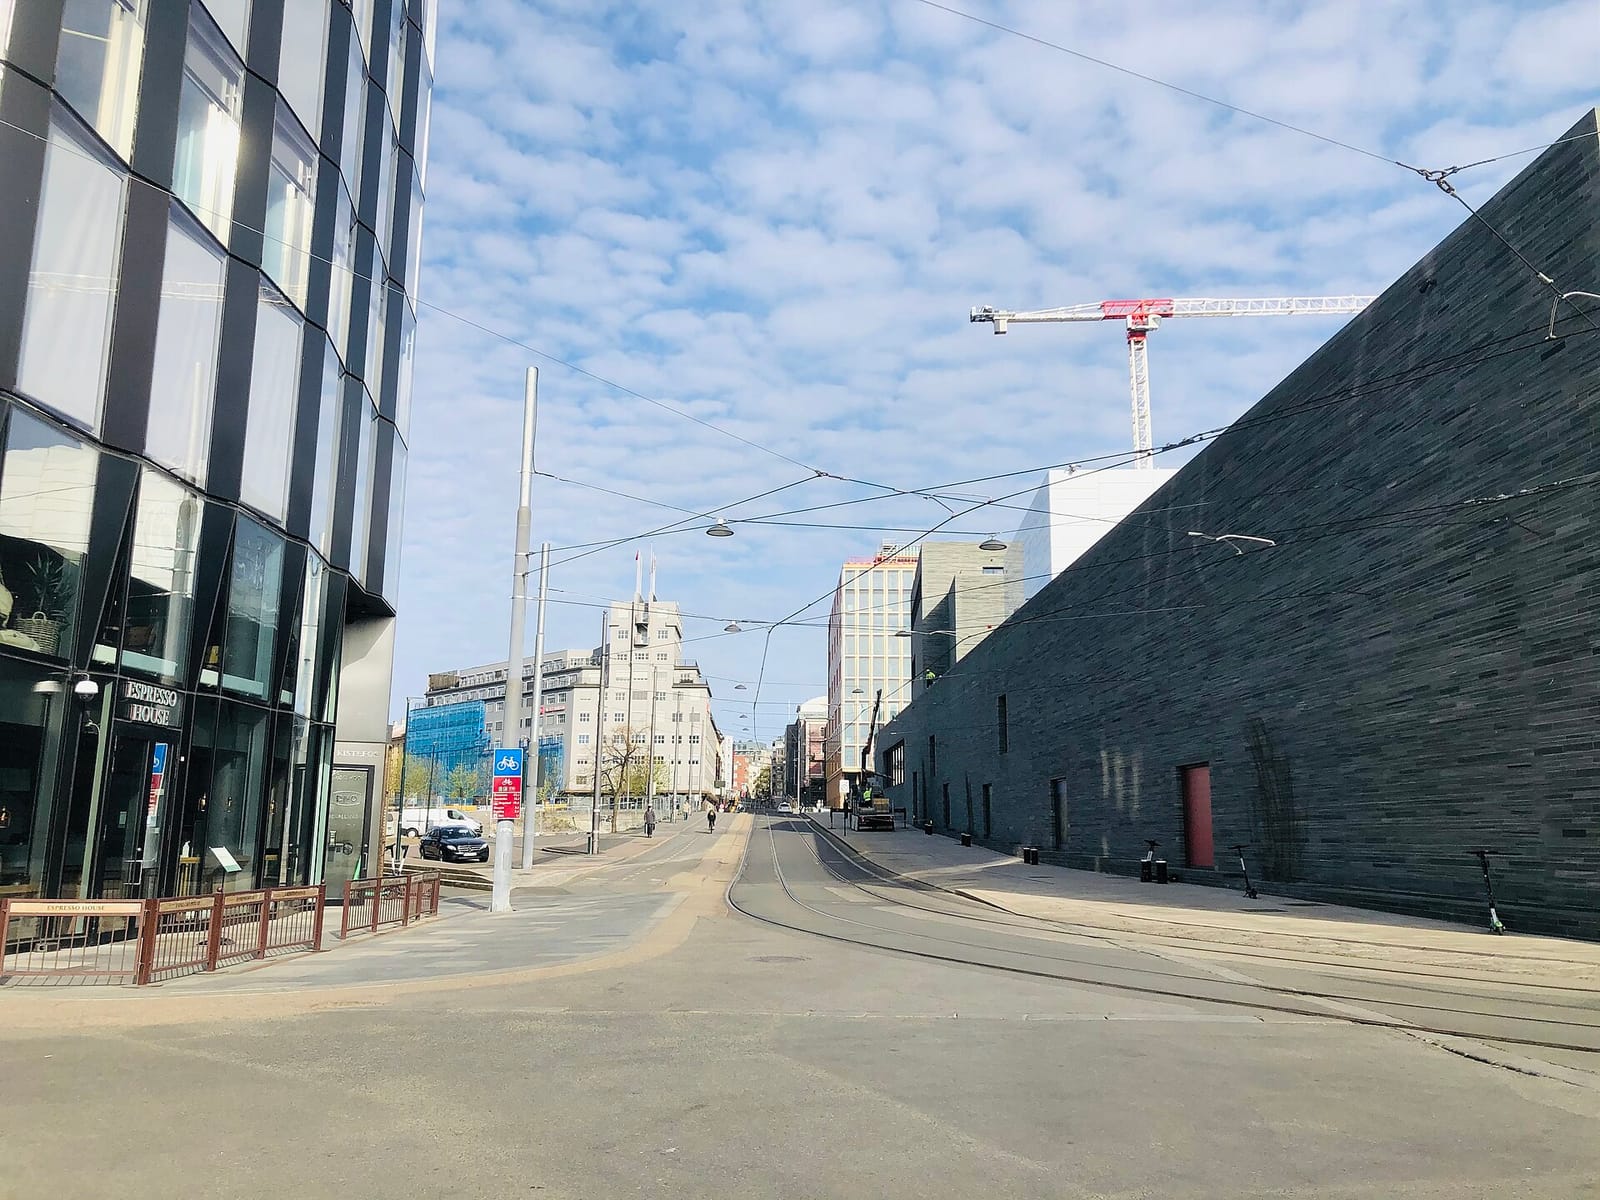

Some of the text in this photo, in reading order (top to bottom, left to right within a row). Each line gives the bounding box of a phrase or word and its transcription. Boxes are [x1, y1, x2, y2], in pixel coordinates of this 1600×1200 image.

[125, 681, 177, 707] ESPRESSO
[131, 703, 170, 726] HOUSE
[46, 904, 105, 912] ESPRESSO HOUSE
